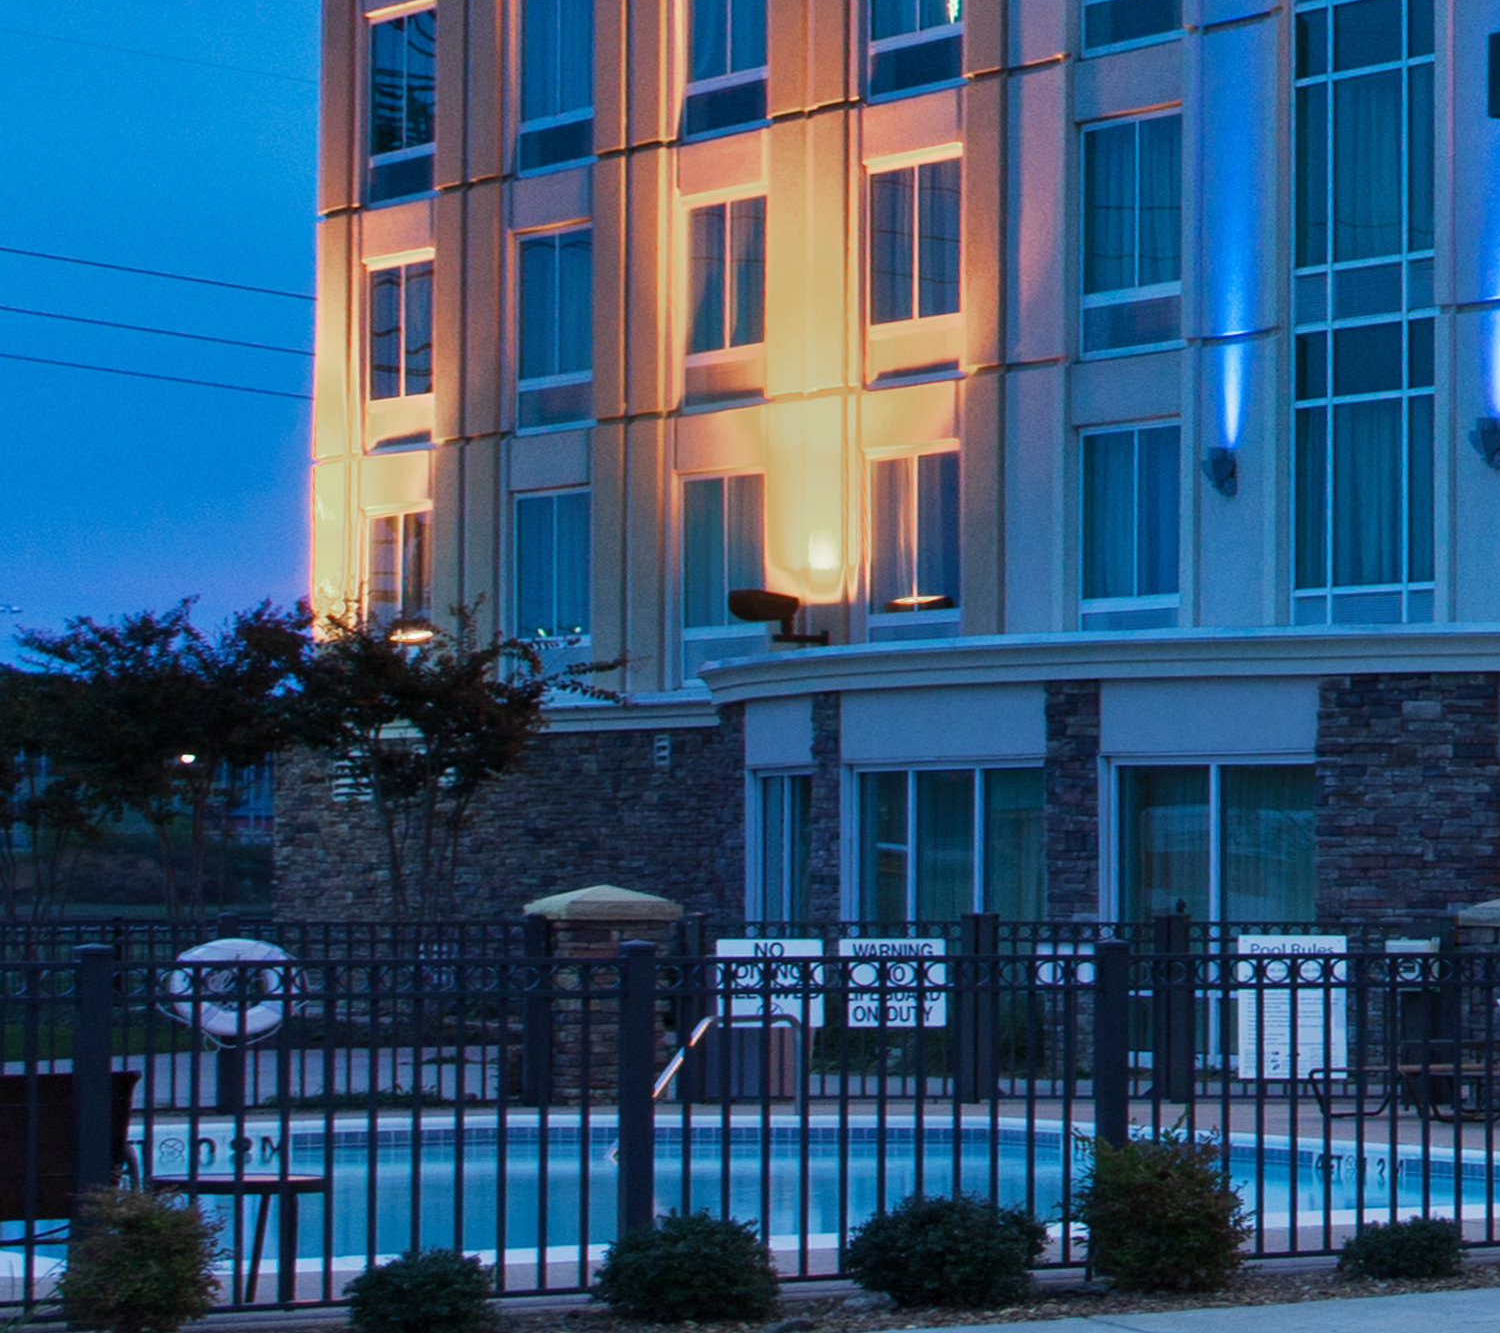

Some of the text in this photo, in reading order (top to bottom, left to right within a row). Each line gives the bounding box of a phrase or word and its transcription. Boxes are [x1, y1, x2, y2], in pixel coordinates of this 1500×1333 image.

[754, 942, 785, 958] NO
[852, 943, 935, 958] WARNING
[1250, 943, 1336, 954] Pool Rules
[853, 1006, 880, 1022] ON
